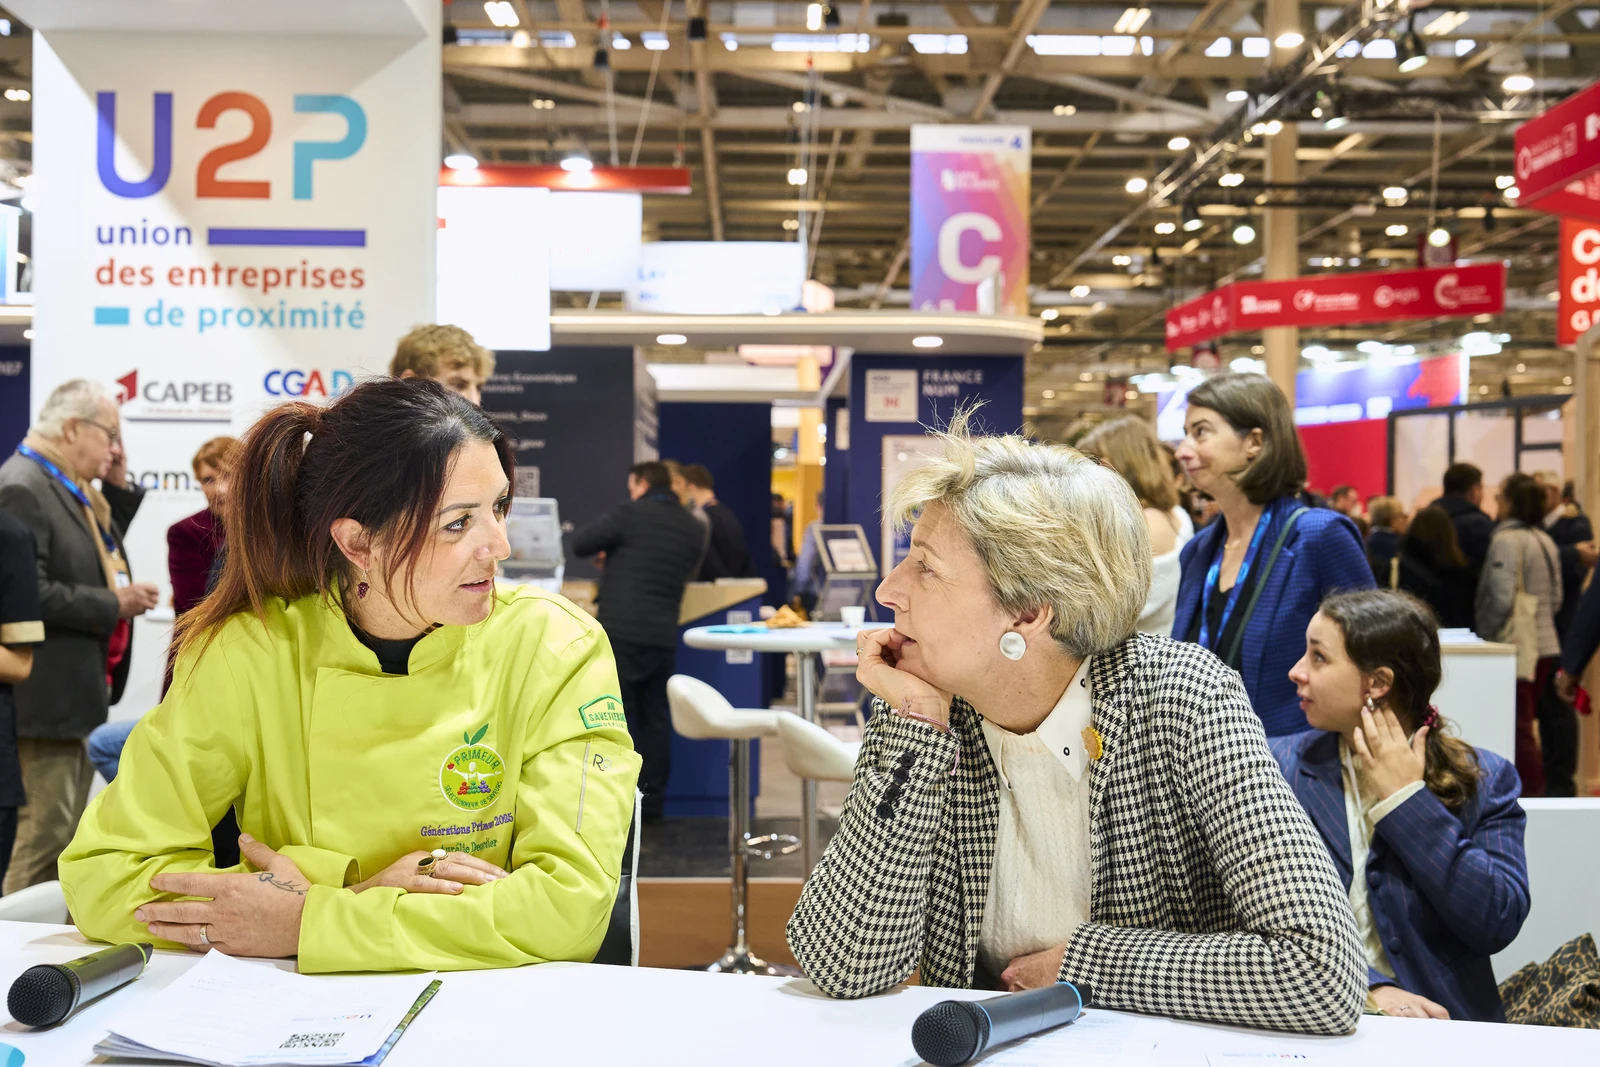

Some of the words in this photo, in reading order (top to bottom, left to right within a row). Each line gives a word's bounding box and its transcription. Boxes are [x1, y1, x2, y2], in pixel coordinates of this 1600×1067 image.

[96, 90, 368, 200] U2P
[96, 218, 193, 246] union
[938, 211, 1003, 284] C
[95, 257, 154, 287] des
[168, 260, 366, 294] entreprises
[144, 301, 185, 328] de
[198, 300, 366, 333] proximité
[263, 369, 355, 397] CGAD
[921, 369, 984, 385] FRANCE
[142, 381, 233, 404] CAPEB
[454, 749, 501, 770] PRIMEUR
[420, 824, 471, 837] Générations
[494, 812, 514, 827] 2025
